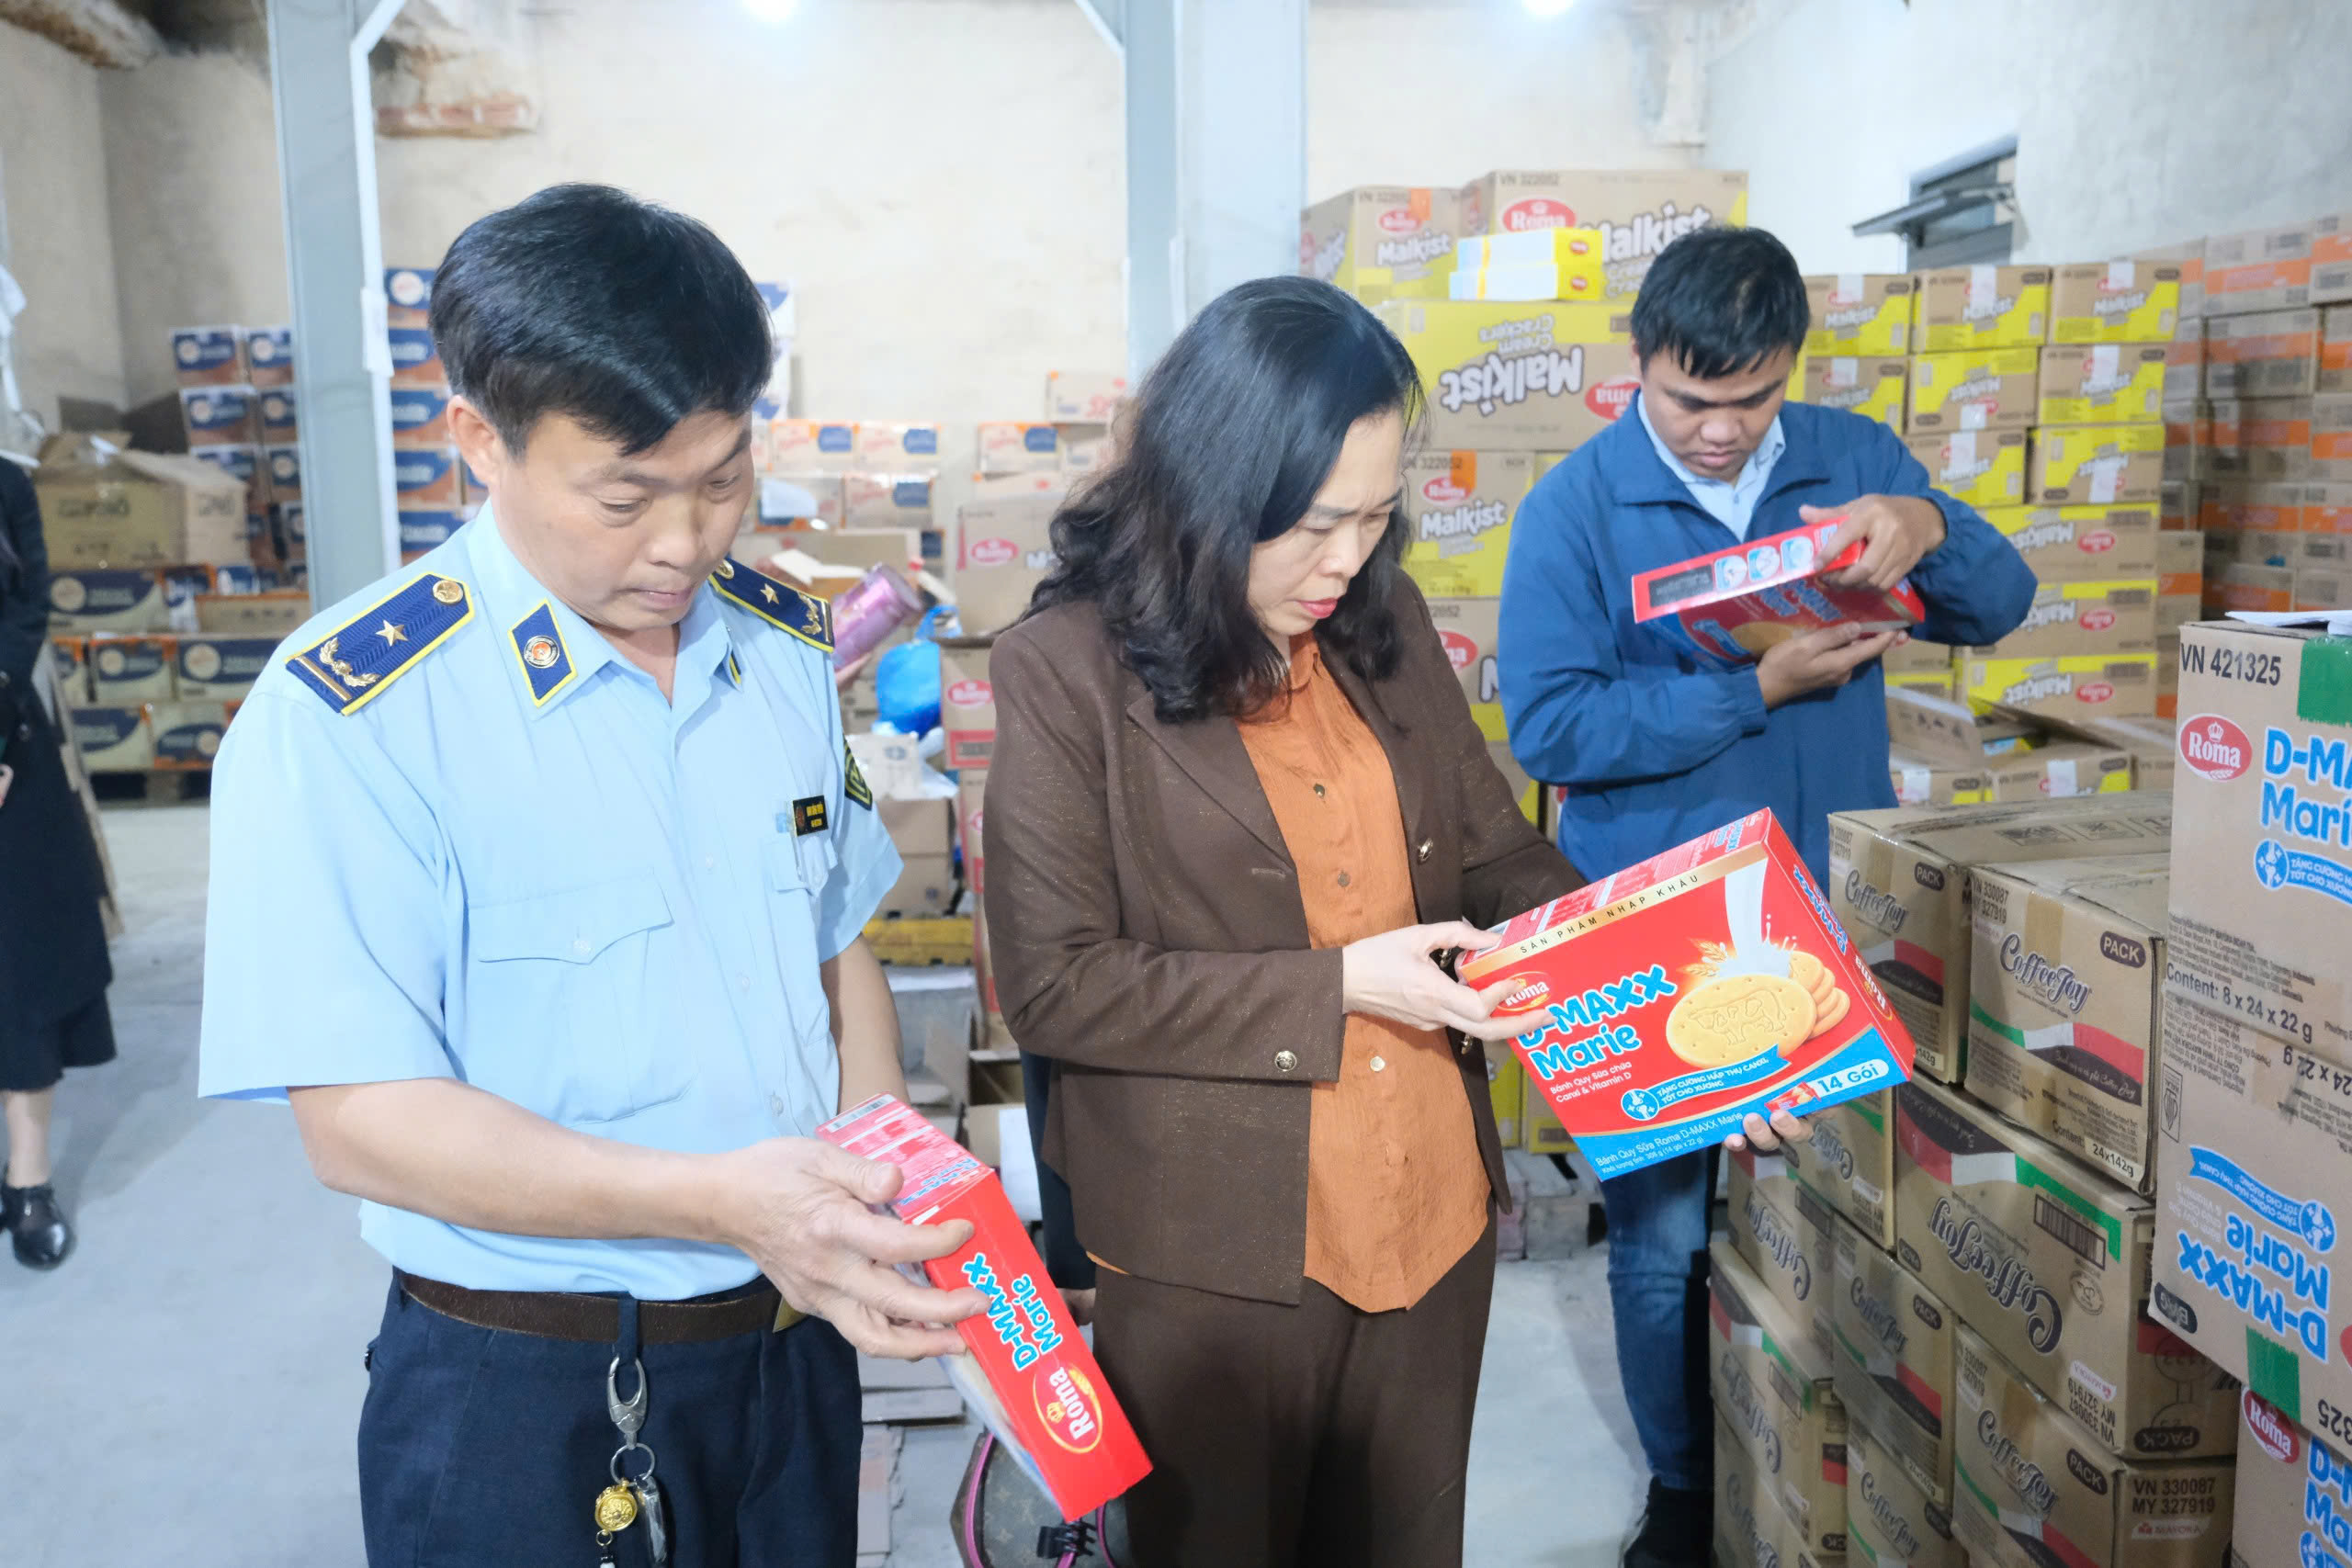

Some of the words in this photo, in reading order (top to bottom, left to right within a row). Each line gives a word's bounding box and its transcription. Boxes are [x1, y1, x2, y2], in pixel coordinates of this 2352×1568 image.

[1440, 344, 1584, 417] Malkist
[1421, 500, 1507, 540] Malkist
[2180, 643, 2205, 674] VN
[2210, 647, 2282, 686] 421325
[2188, 731, 2242, 770] Roma
[2265, 728, 2352, 791] D-M
[2103, 937, 2140, 964] PACK
[2167, 962, 2219, 1000] Content:
[2222, 986, 2232, 1006] 8
[2234, 995, 2244, 1011] x
[2246, 995, 2264, 1021] 24
[2267, 1008, 2277, 1026] x
[2280, 1009, 2299, 1034] 22
[2302, 1022, 2312, 1044] g
[1817, 1075, 1843, 1093] 14
[1847, 1063, 1880, 1083] Gói
[1655, 1133, 1681, 1146] Roma
[1679, 1121, 1719, 1138] D-MAXX
[2092, 1143, 2134, 1178] 24x142g
[2177, 1231, 2328, 1364] D-MAXX
[1048, 1366, 1097, 1439] Roma
[2250, 1397, 2292, 1457] Roma
[2069, 1453, 2104, 1493] PACK
[2133, 1478, 2156, 1495] VN
[2162, 1477, 2217, 1495] 330087
[2132, 1497, 2157, 1514] MY
[2160, 1497, 2216, 1514] 327919
